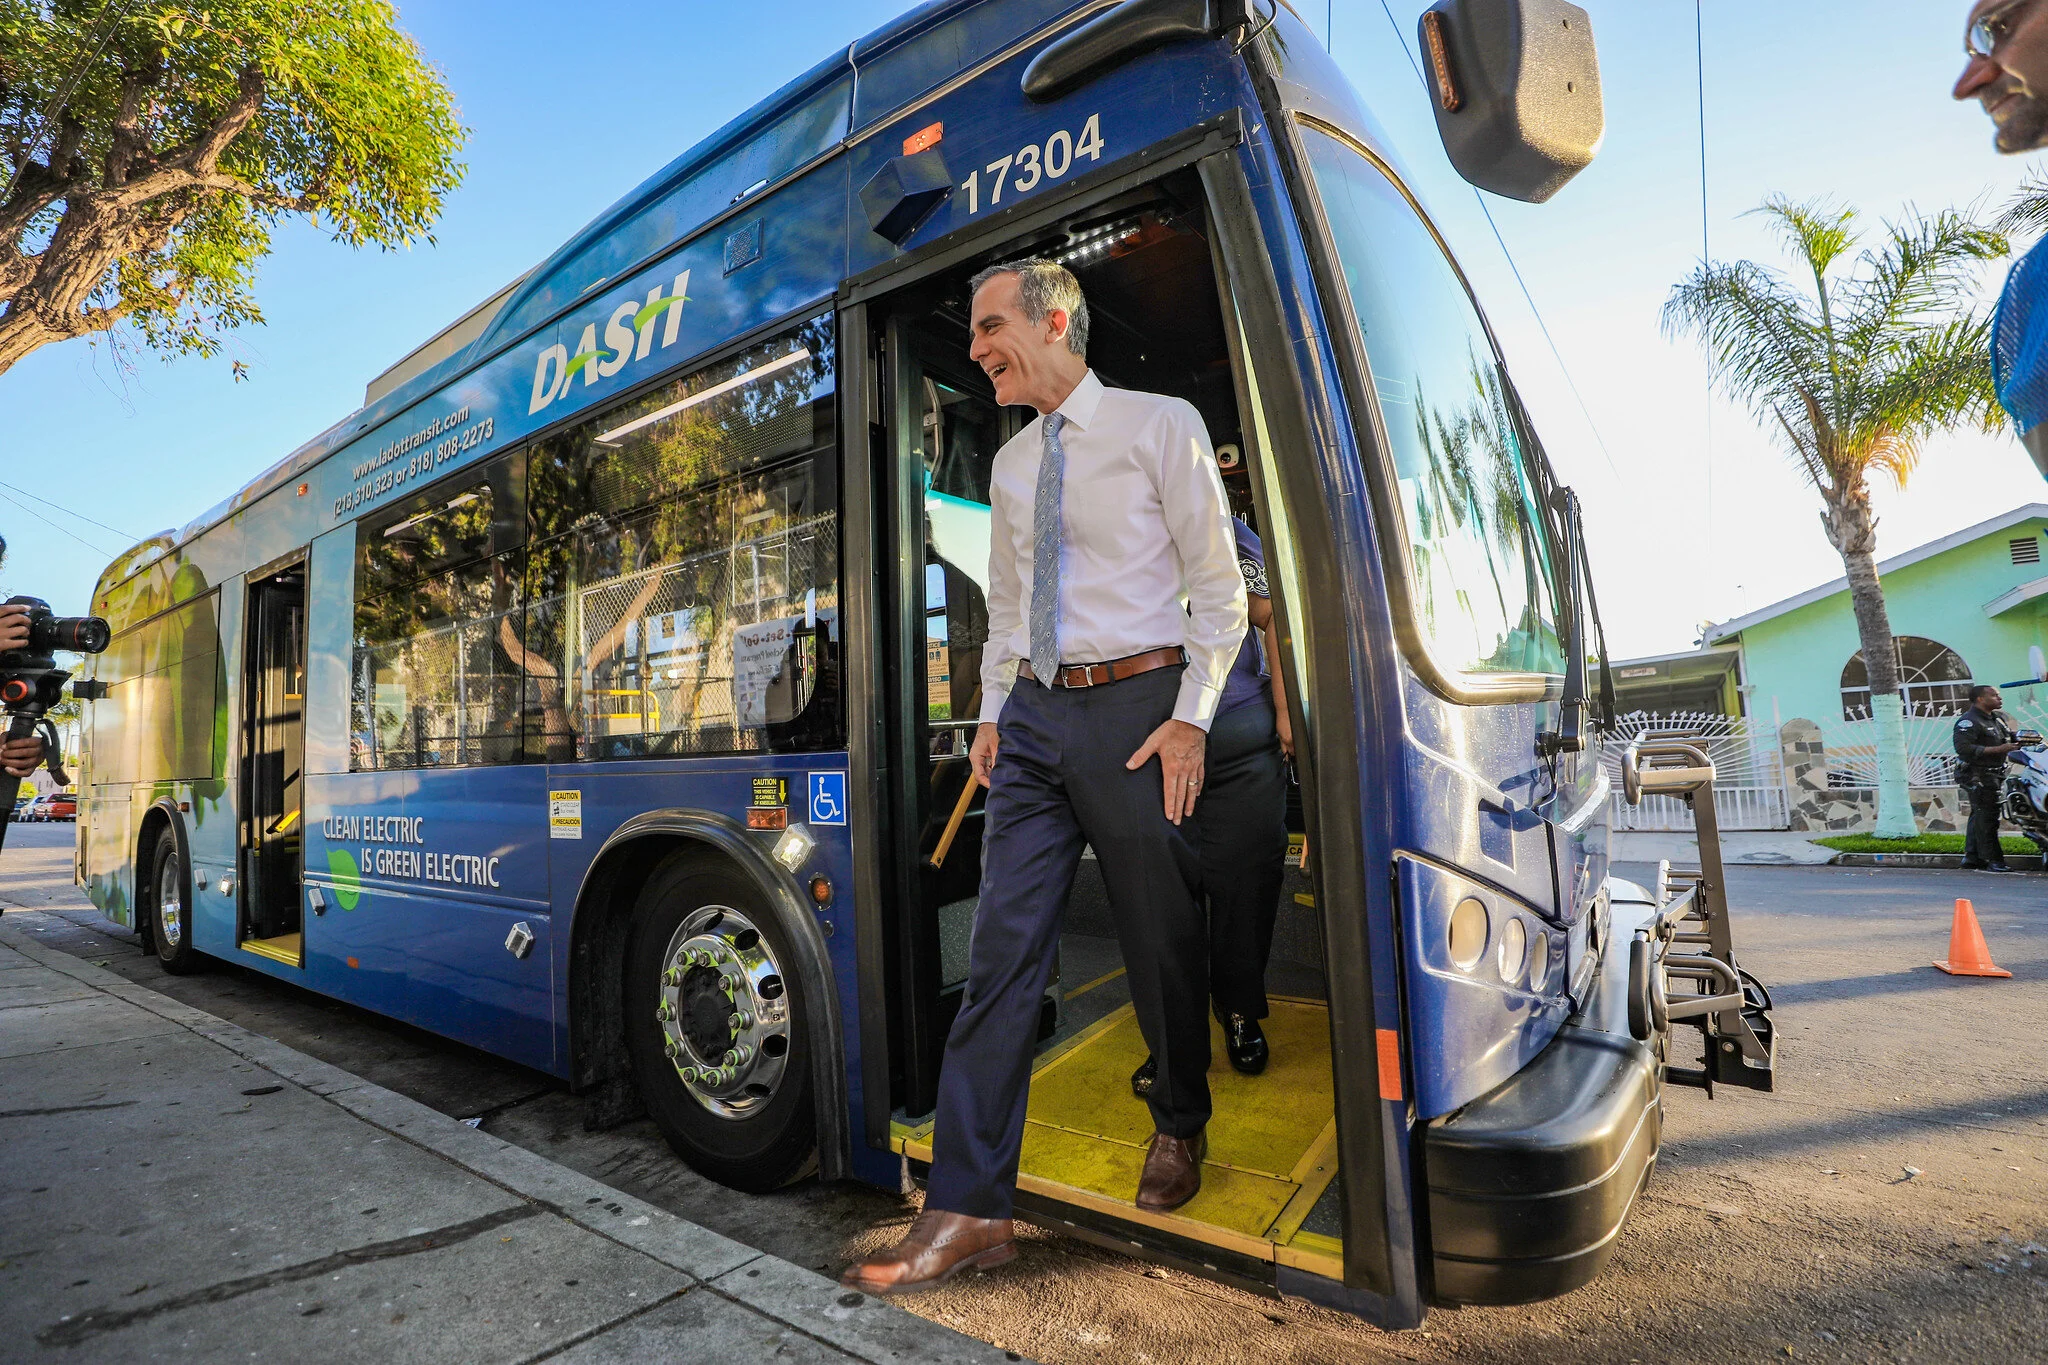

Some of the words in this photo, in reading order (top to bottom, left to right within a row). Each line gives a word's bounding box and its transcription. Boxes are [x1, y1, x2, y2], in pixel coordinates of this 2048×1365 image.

[961, 112, 1104, 214] 17304
[528, 268, 692, 416] DASH
[352, 405, 470, 480] www.ladottransit.com
[396, 466, 407, 484] or
[410, 448, 433, 477] 818)
[437, 417, 493, 462] 808-2273
[556, 792, 578, 800] CAUTION
[753, 778, 777, 786] CAUTION
[323, 815, 360, 840] CLEAN
[363, 815, 424, 844] ELECTRIC
[361, 847, 372, 873] IS
[376, 848, 421, 879] GREEN
[425, 852, 500, 888] ELECTRIC
